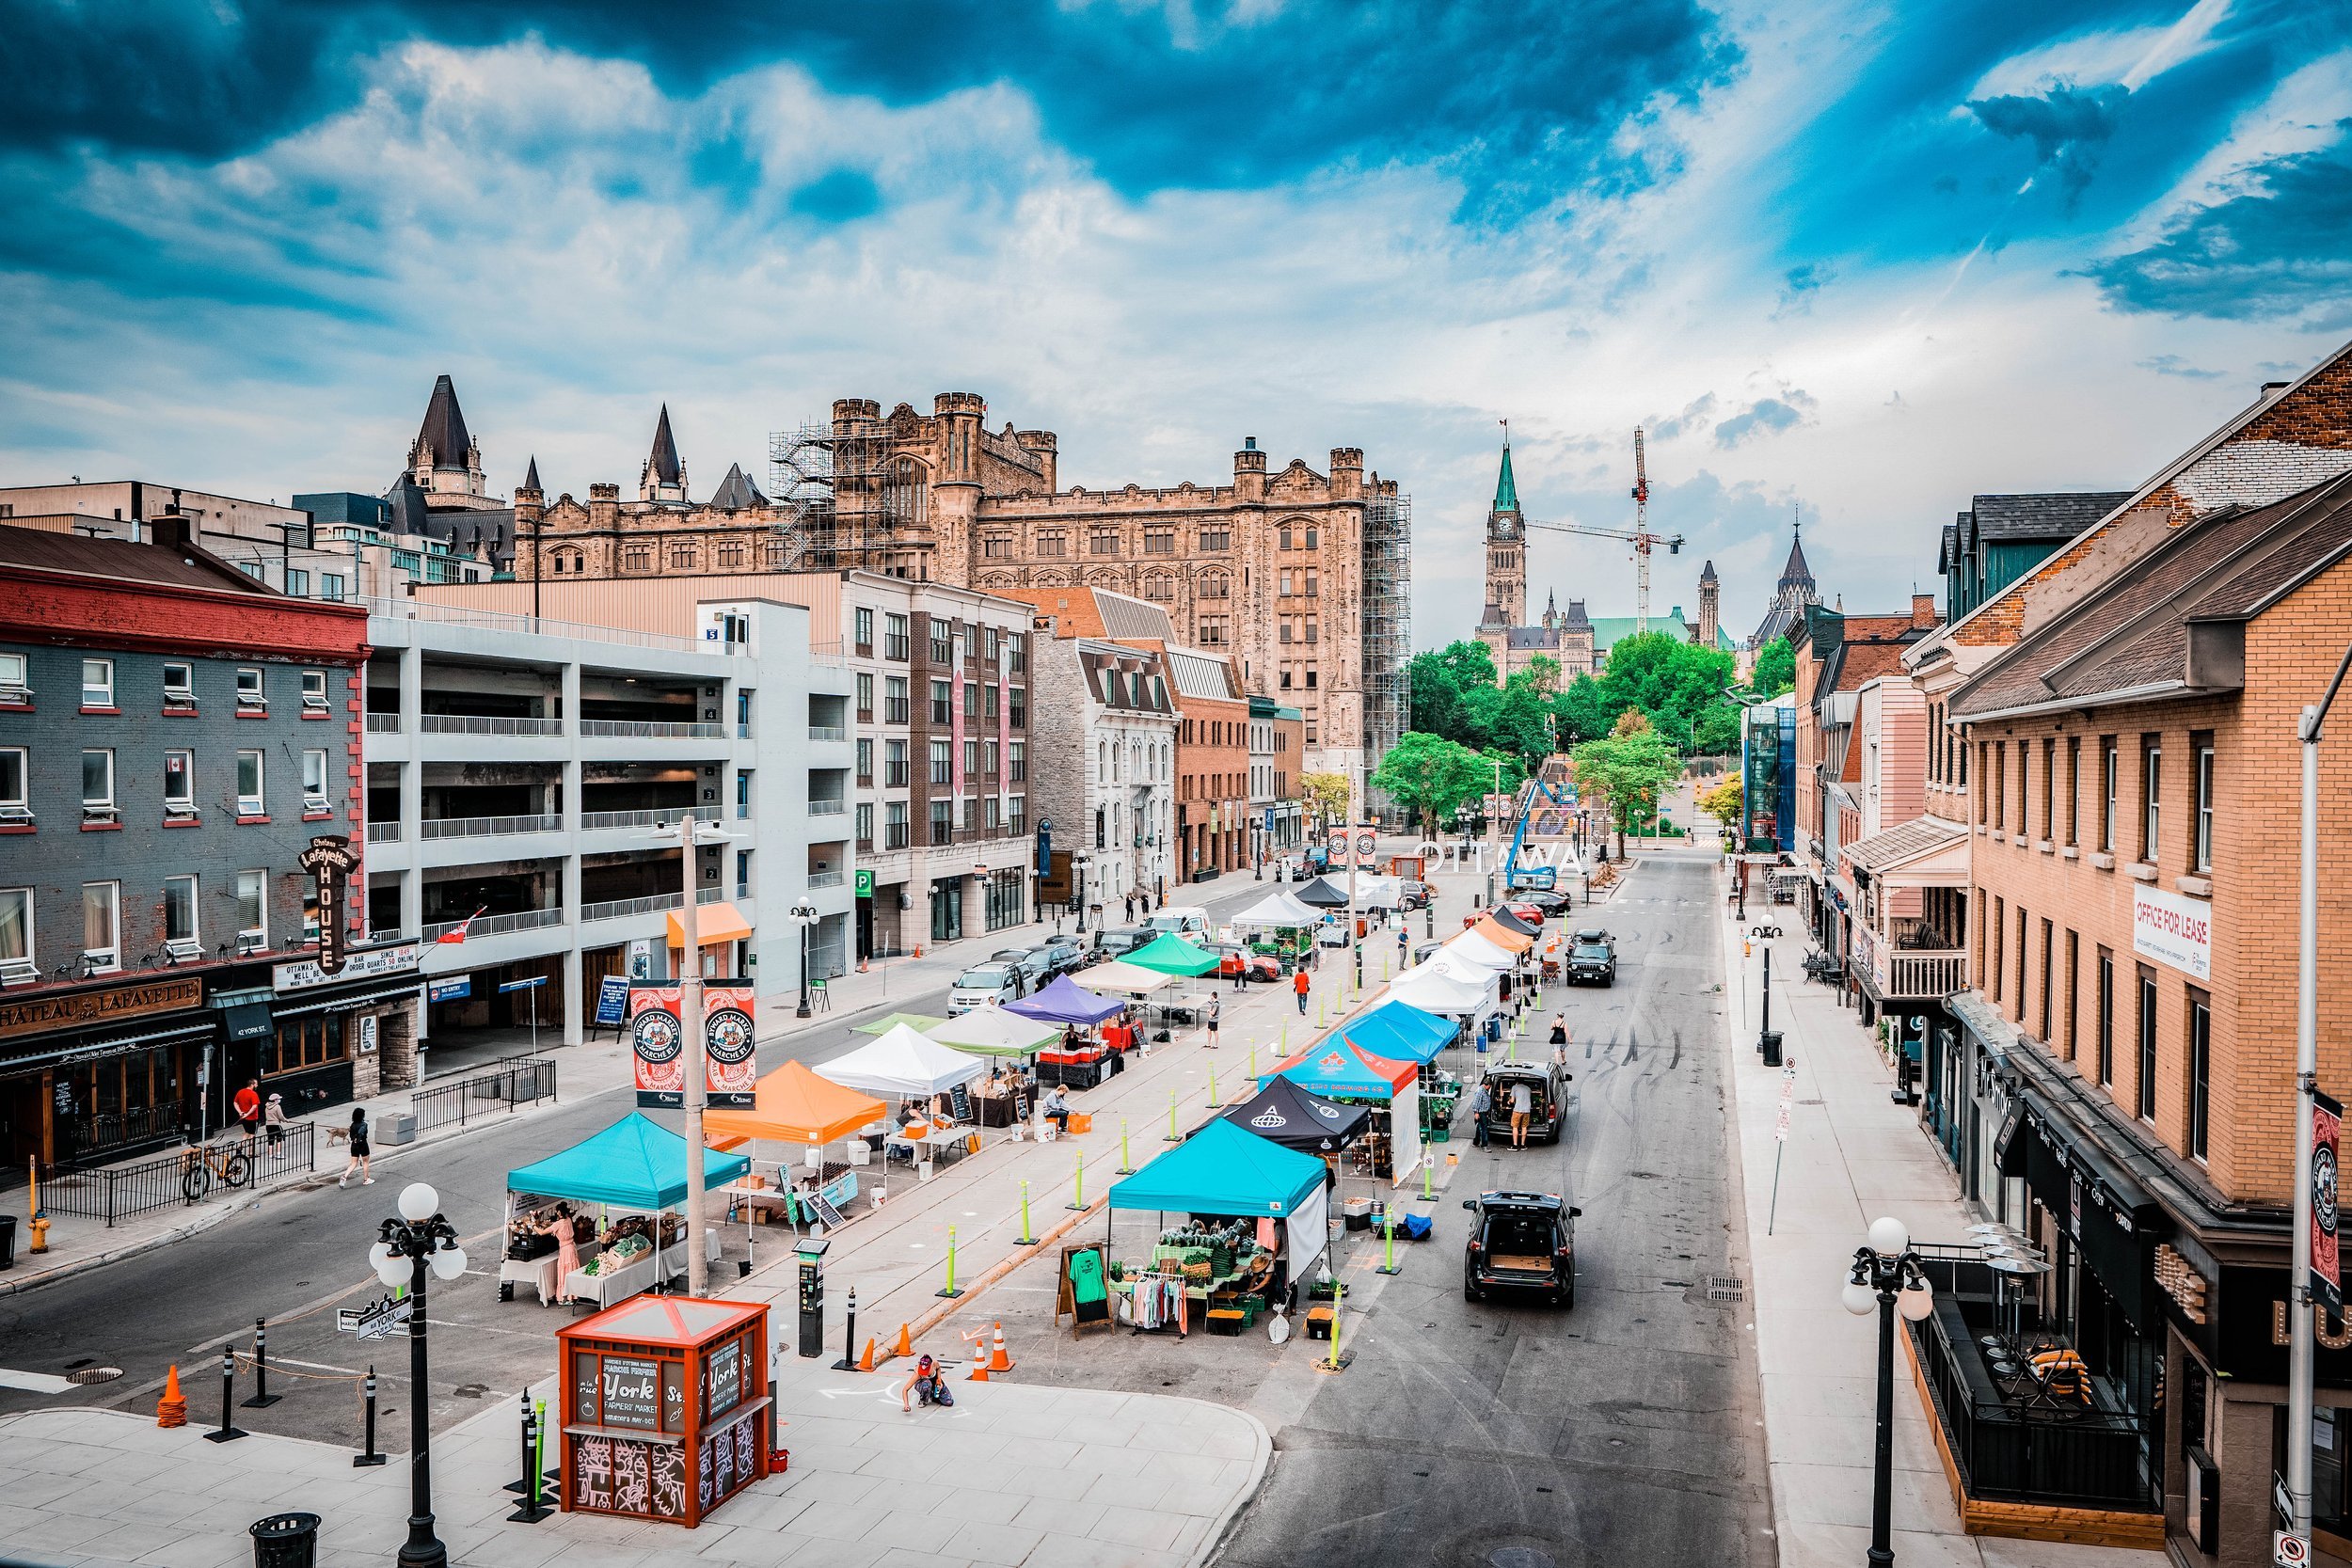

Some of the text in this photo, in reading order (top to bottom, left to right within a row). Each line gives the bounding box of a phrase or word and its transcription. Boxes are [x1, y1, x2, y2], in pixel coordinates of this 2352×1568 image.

[709, 630, 716, 640] 5
[707, 710, 714, 720] 4
[707, 790, 713, 800] 3
[301, 848, 348, 867] Lafayette
[1413, 841, 1583, 875] OTTAWA
[708, 869, 715, 879] 2
[321, 866, 333, 968] HOUSE
[2137, 901, 2207, 945] OFFICE FOR LEASE
[380, 950, 394, 959] SINCE
[398, 948, 410, 957] 1849
[349, 963, 365, 972] ORDER
[367, 959, 387, 969] QUARTS
[397, 955, 414, 963] ONLINE
[0, 983, 195, 1027] HATEAU LAFAYETTE
[636, 1014, 677, 1037] BYWARD MARKET
[707, 1014, 752, 1037] BYWARD MARKET
[666, 1047, 675, 1055] BY
[739, 1046, 747, 1055] BY
[659, 1092, 679, 1102] Ottawa
[730, 1093, 752, 1103] Ottawa
[376, 1310, 397, 1328] YORK
[743, 1353, 753, 1370] St.
[595, 1372, 654, 1402] York
[667, 1386, 685, 1403] St.
[634, 1404, 658, 1415] MARKET
